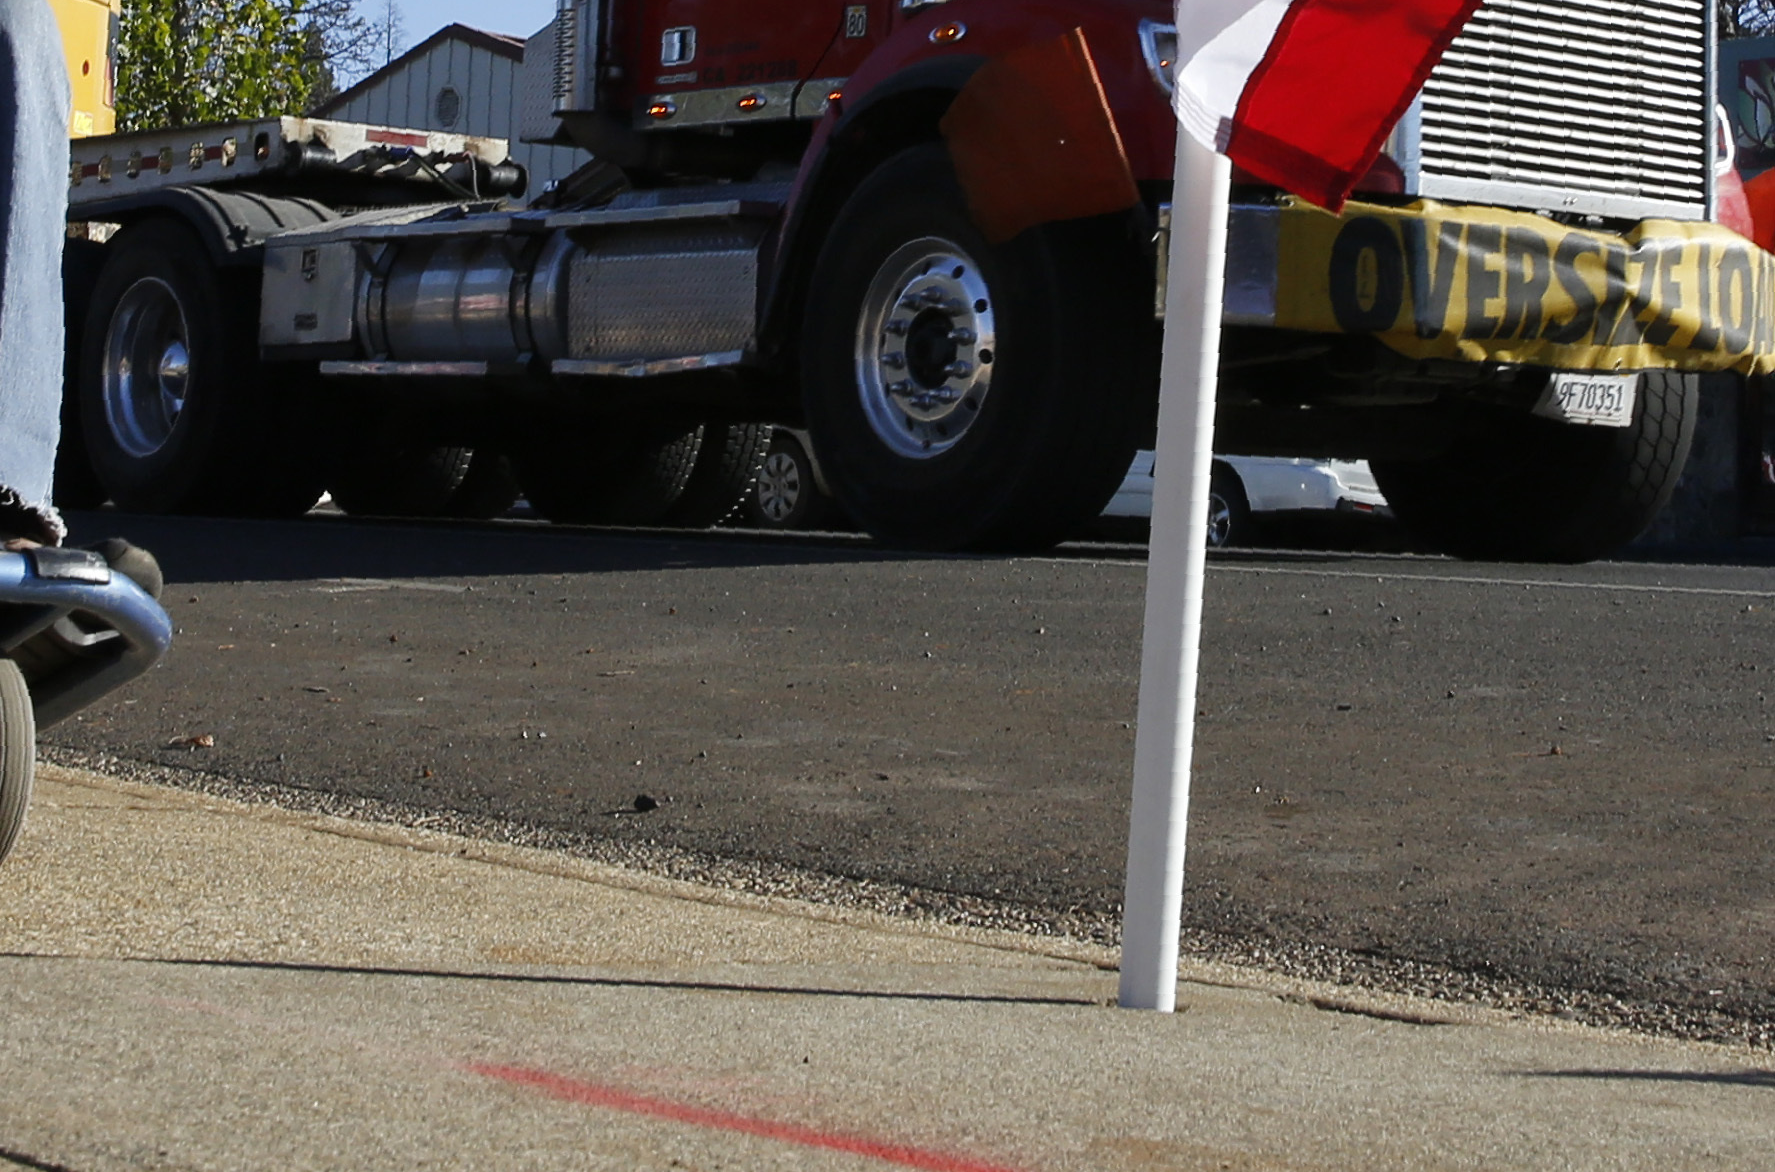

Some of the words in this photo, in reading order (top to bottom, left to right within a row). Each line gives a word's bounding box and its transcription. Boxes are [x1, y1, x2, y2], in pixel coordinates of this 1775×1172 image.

[848, 13, 865, 35] 80
[1328, 216, 1683, 348] OVERSIZE
[1557, 382, 1623, 411] 9F70351
